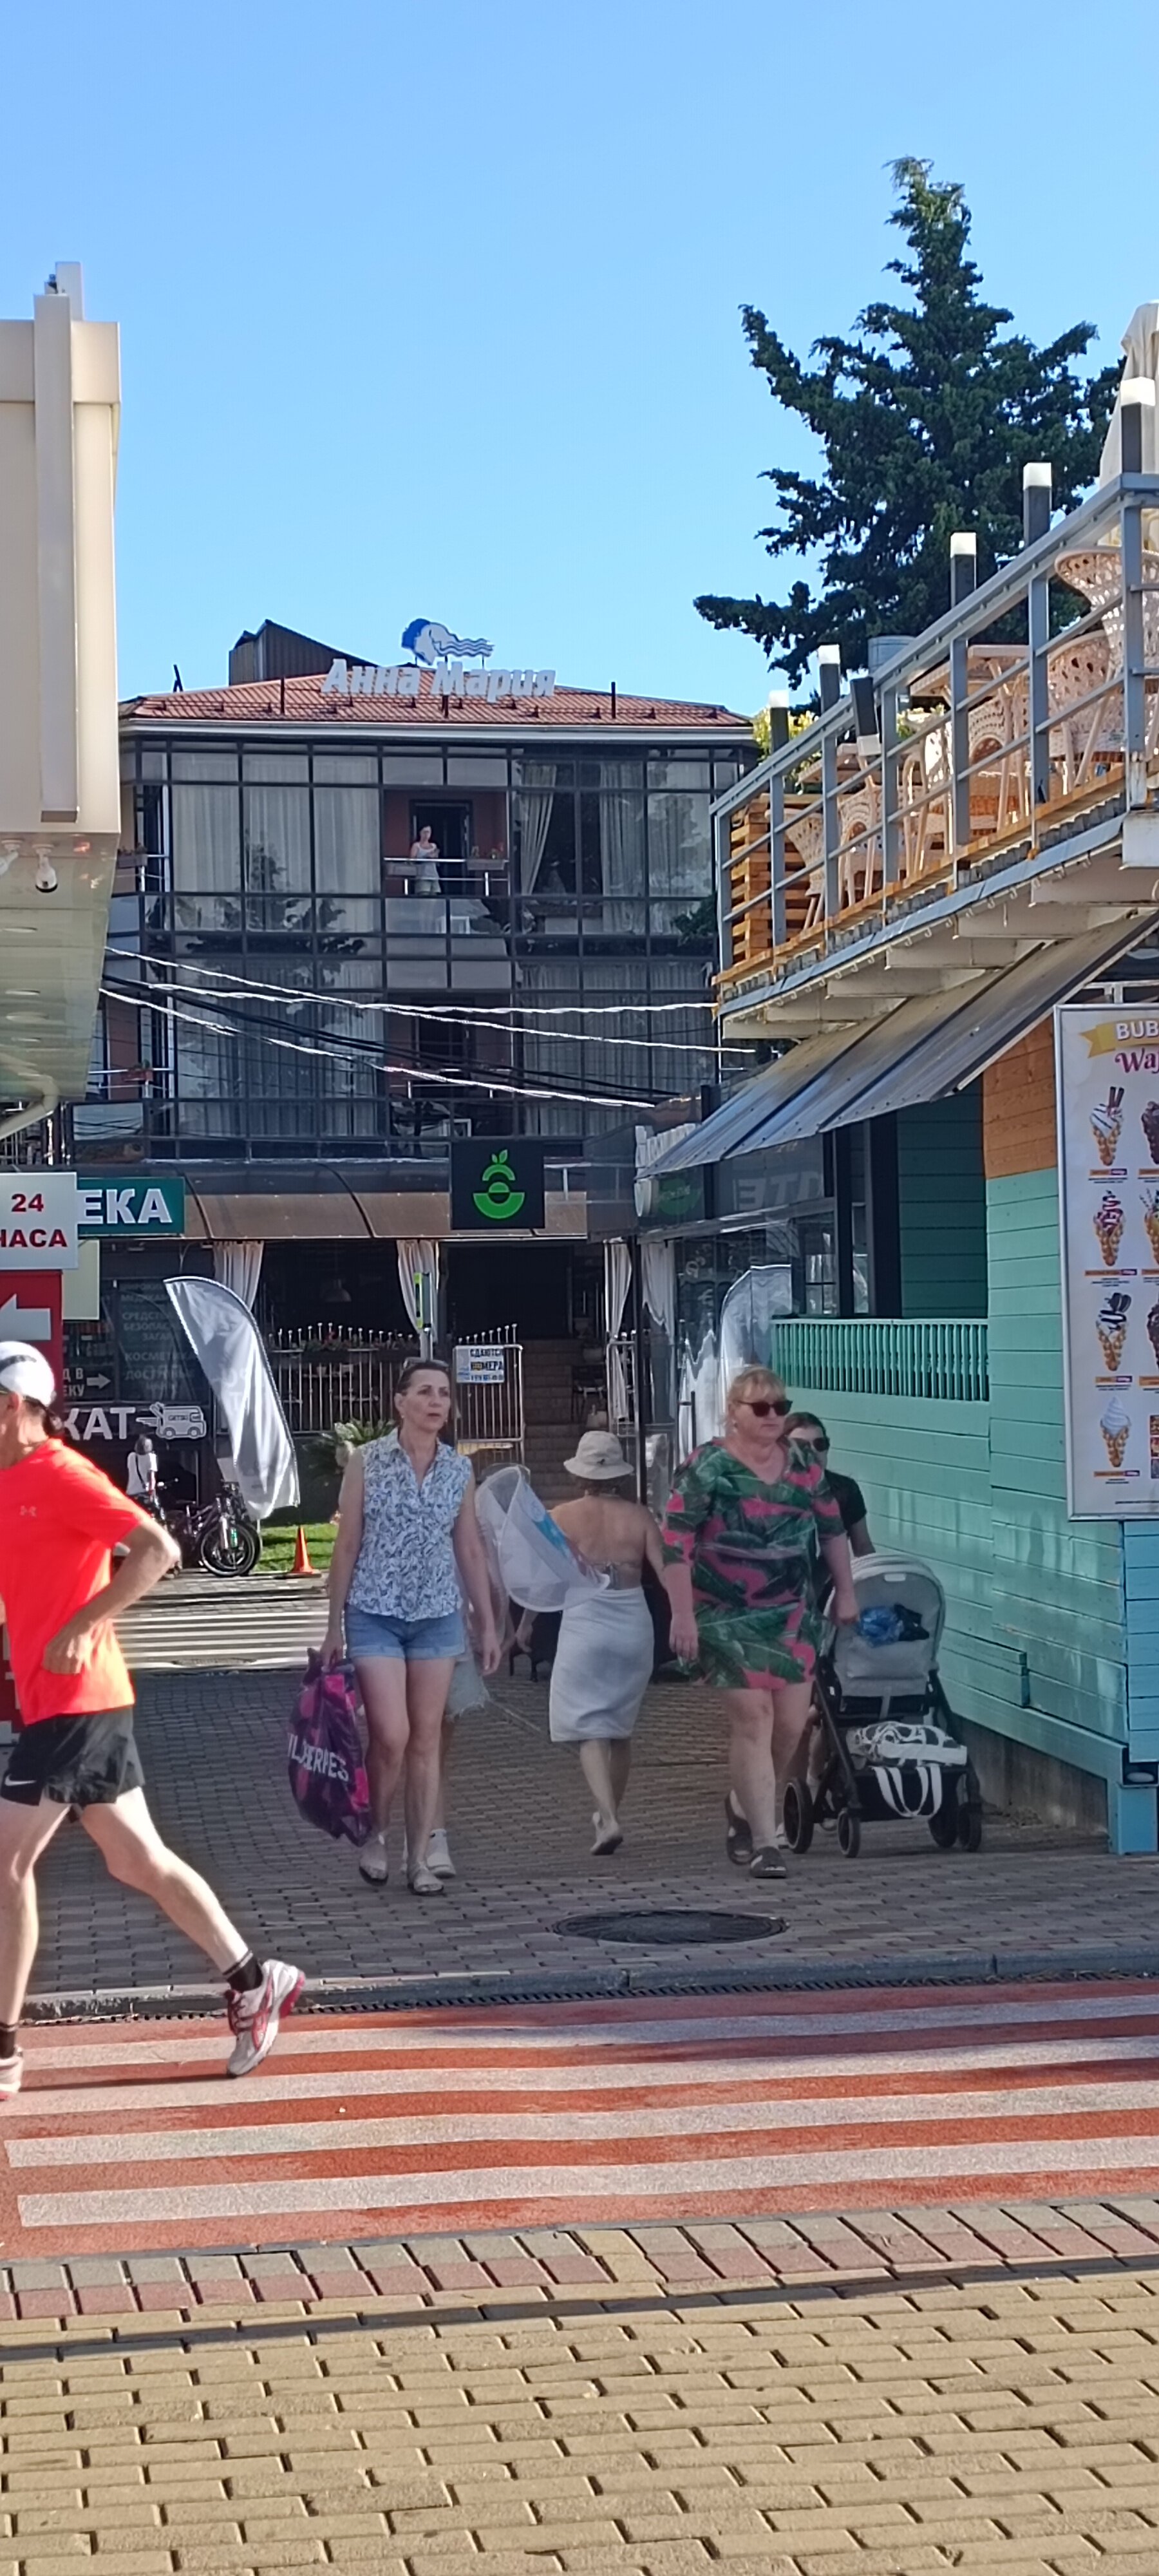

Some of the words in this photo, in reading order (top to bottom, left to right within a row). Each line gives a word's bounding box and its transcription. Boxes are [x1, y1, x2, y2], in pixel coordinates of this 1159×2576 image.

[323, 658, 421, 694] Анна
[431, 661, 556, 703] Мария
[11, 1193, 44, 1212] 24
